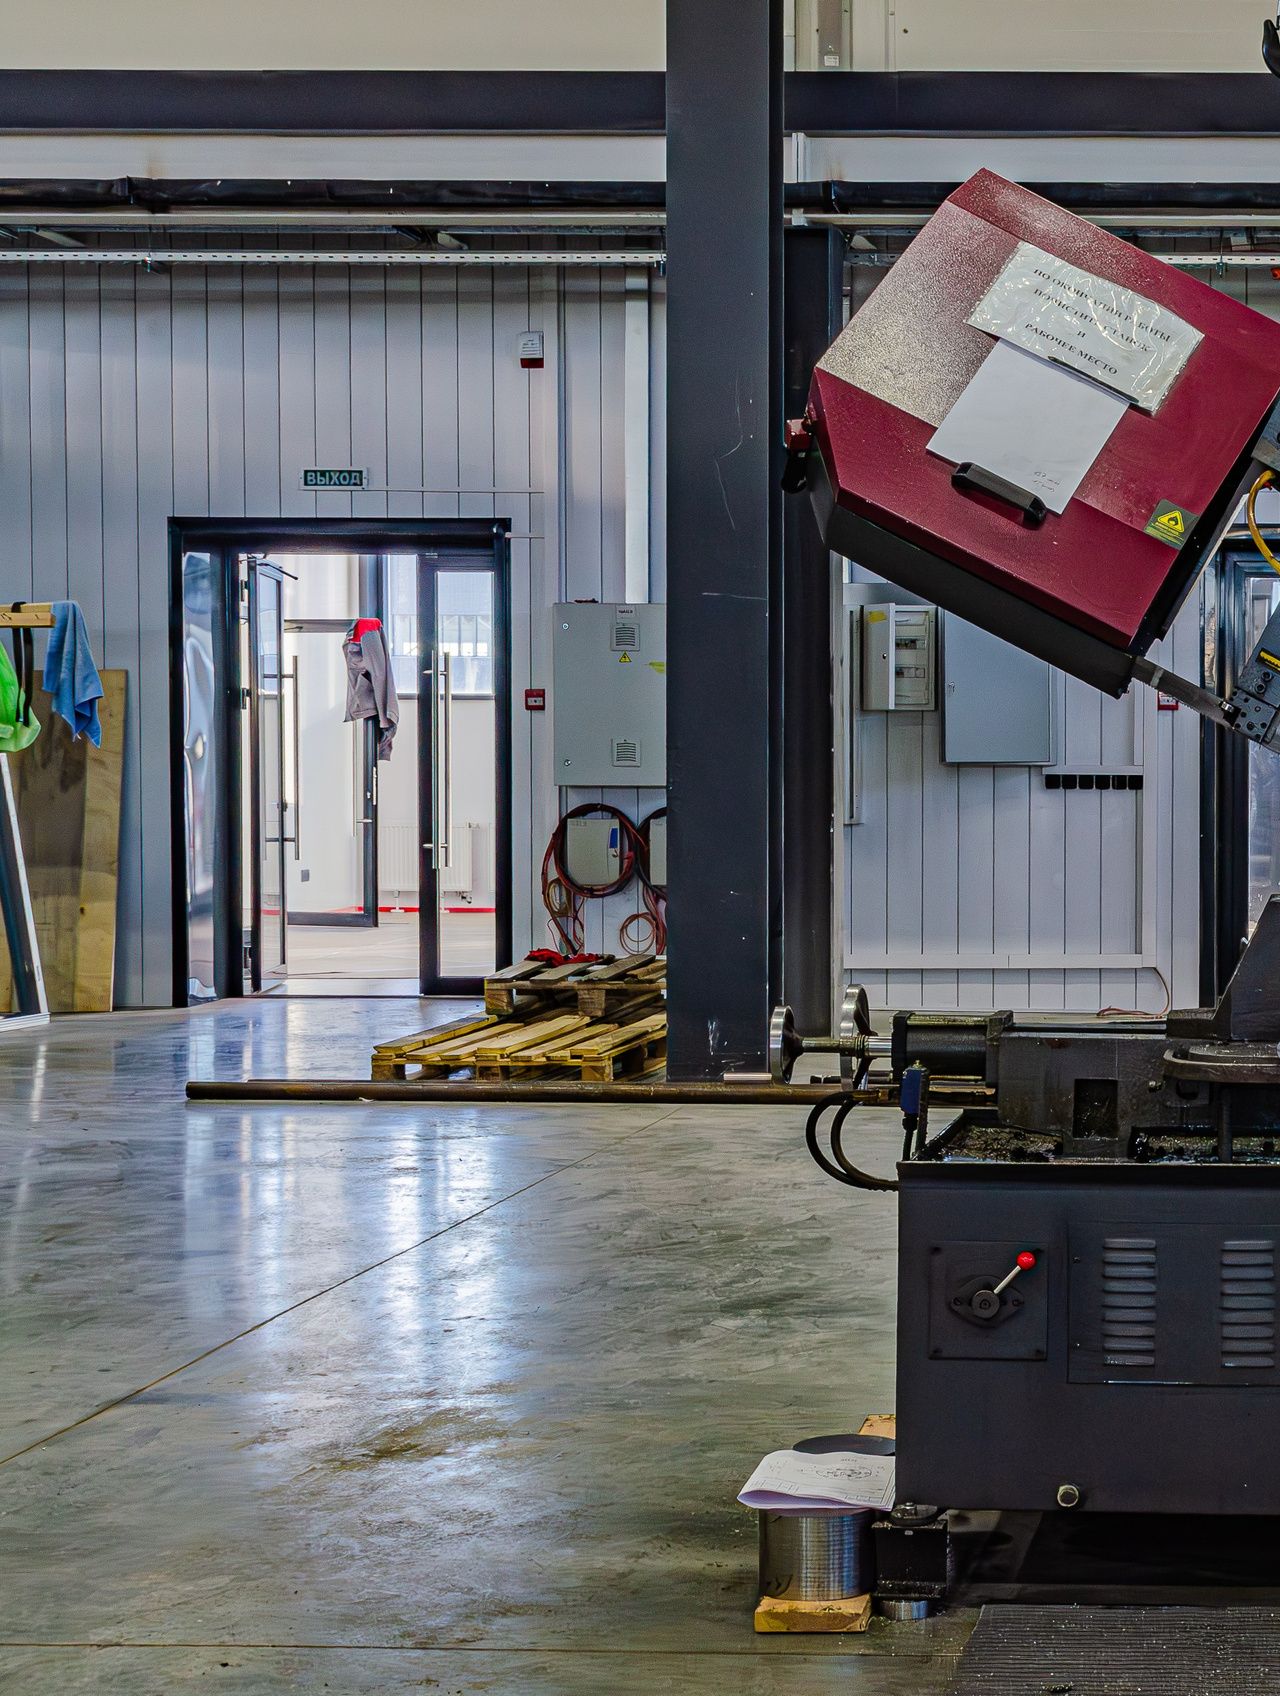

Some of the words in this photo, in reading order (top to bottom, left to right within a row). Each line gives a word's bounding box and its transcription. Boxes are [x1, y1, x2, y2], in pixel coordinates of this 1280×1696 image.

[1033, 269, 1050, 280] ПО
[1034, 289, 1098, 326] ПОЧИСТИТЬ
[1025, 323, 1077, 353] РАБОЧЕЕ
[1077, 350, 1118, 375] МЕСТО
[306, 471, 361, 486] ВЫХОД
